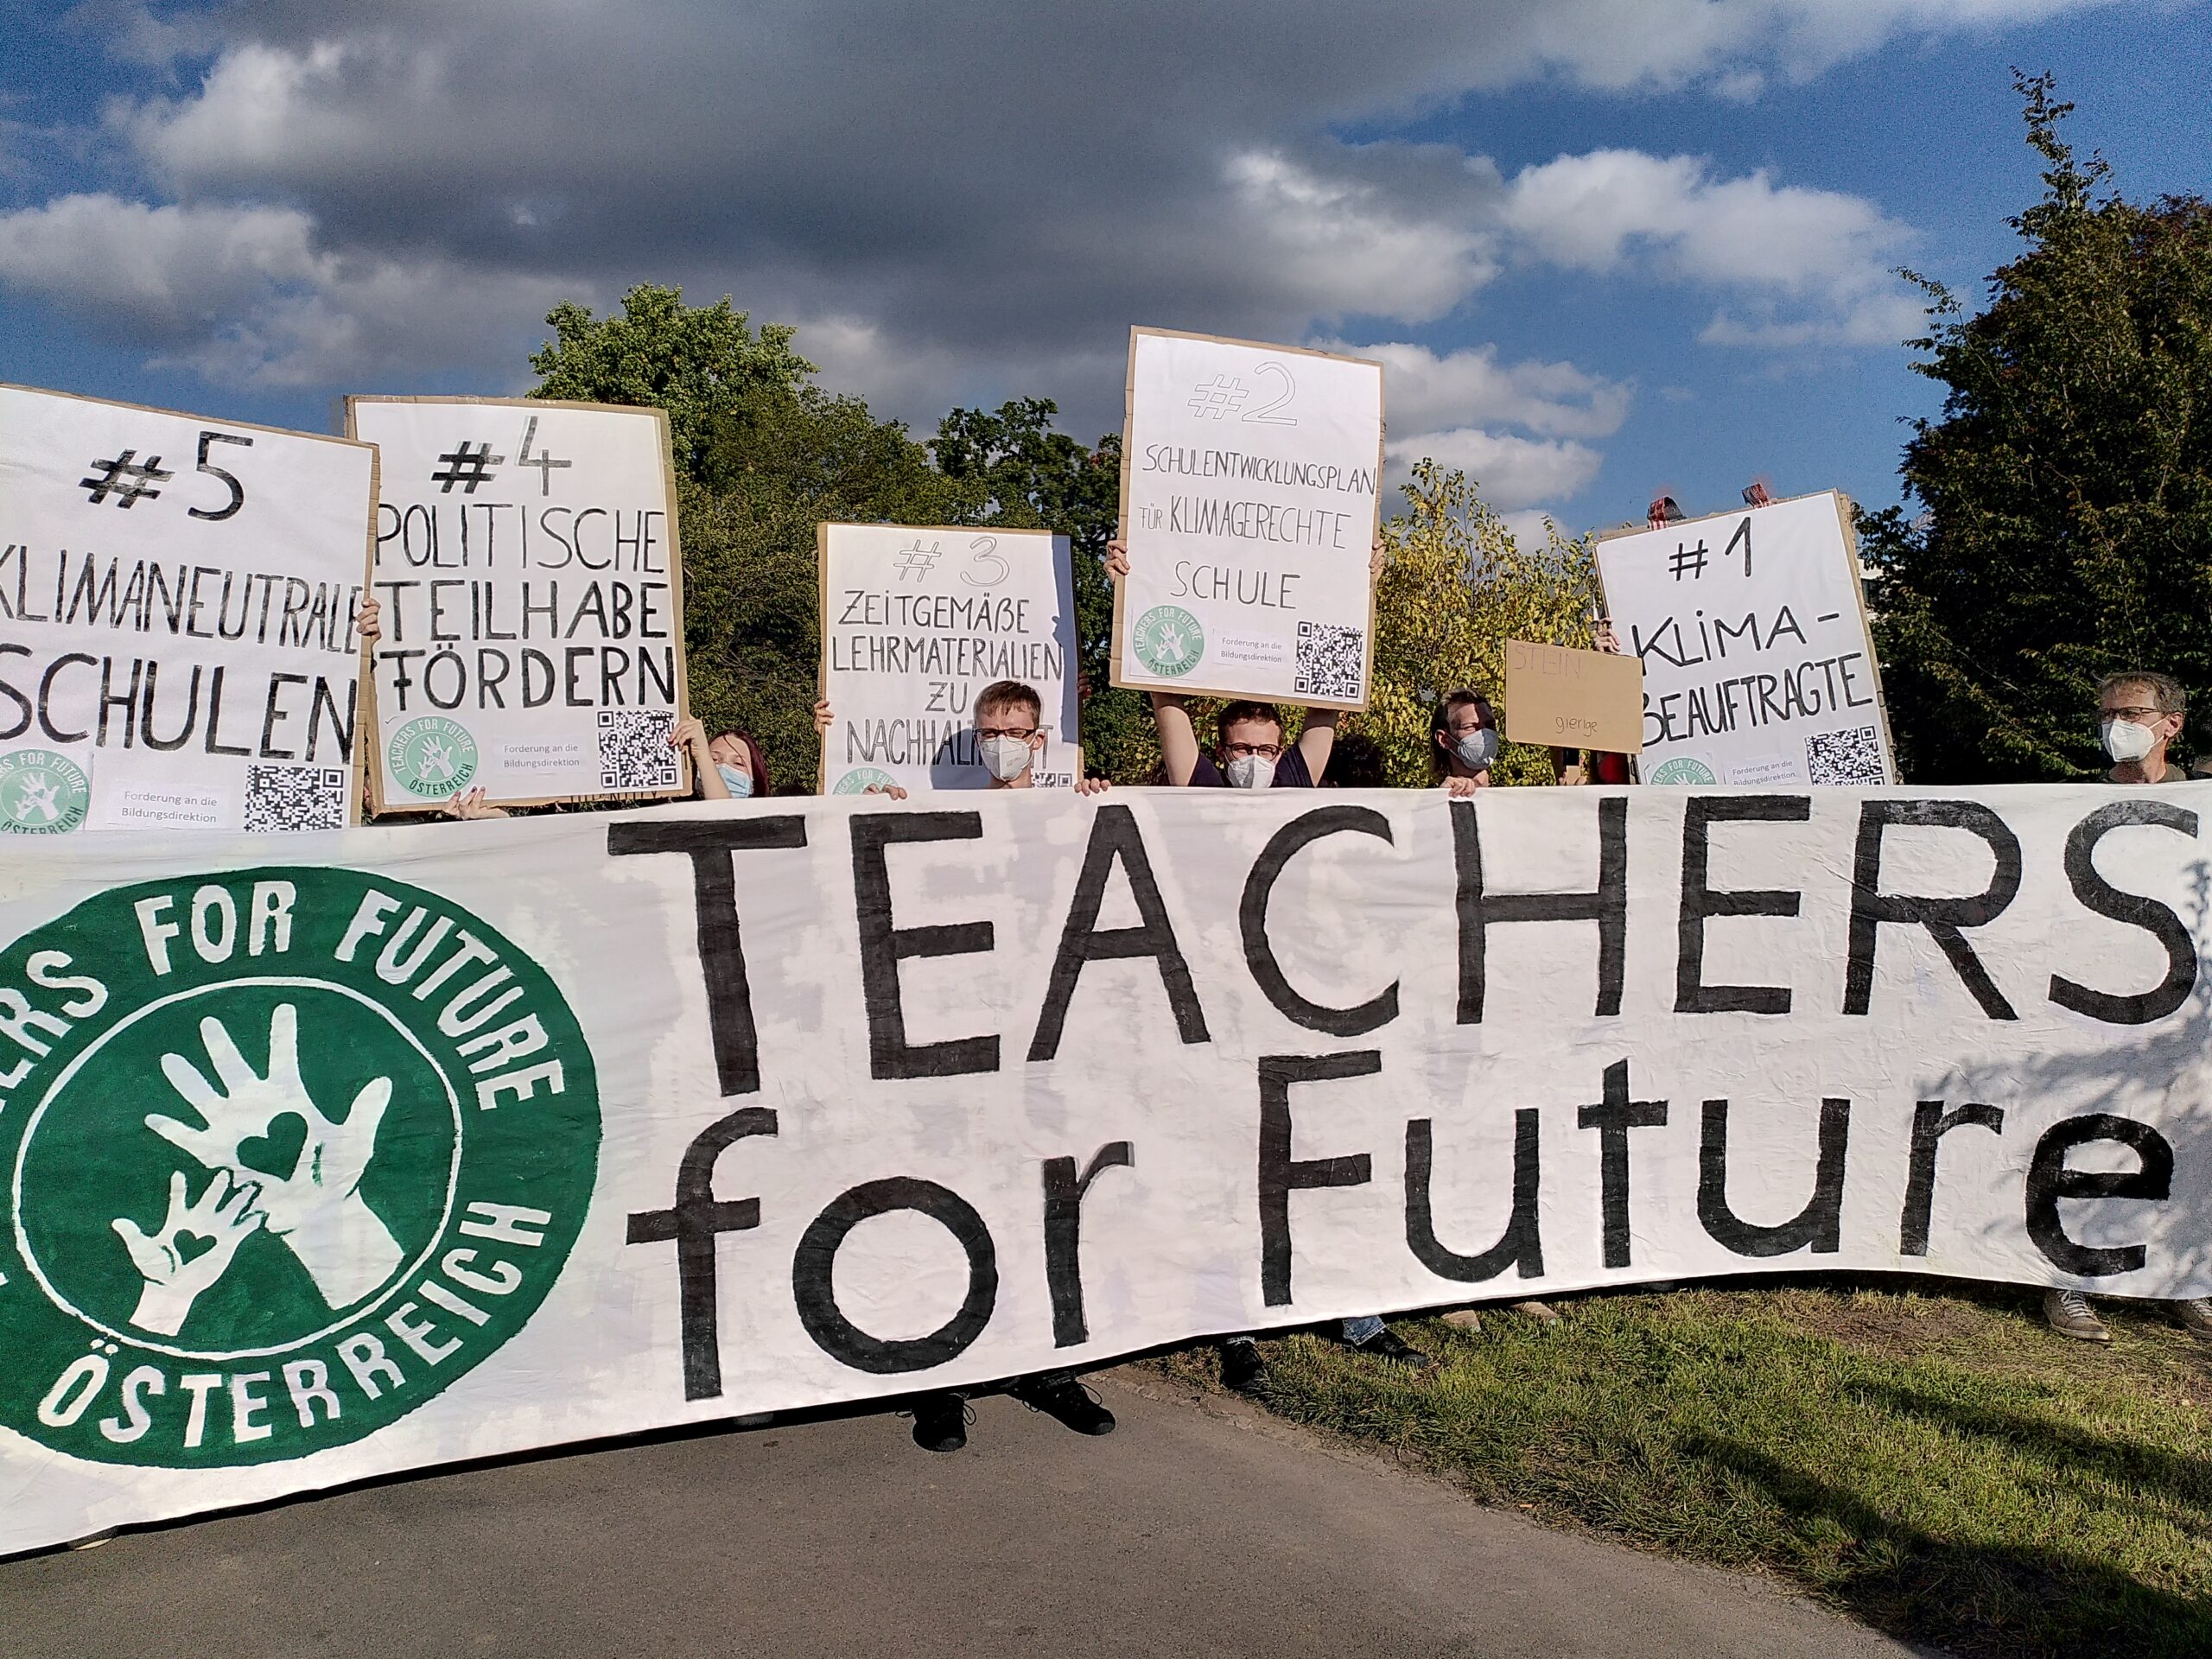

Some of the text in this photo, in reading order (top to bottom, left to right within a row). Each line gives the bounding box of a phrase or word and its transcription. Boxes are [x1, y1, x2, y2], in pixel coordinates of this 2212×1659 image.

[1142, 444, 1376, 495] SCHULENTWICKLUNGSPLAN
[375, 503, 665, 573] POLITISCHE
[1170, 495, 1352, 550] KLIMAGERECHTE
[1170, 561, 1300, 609] SCHULE
[374, 580, 668, 642] TEILHABE
[1134, 607, 1202, 652] TEACHERS FOR FUTURE
[832, 636, 1062, 680] LEHRMATERIALIEN
[1147, 650, 1199, 676] ÖSTERREICH
[1221, 650, 1282, 663] Bildungsdirektion
[1222, 638, 1259, 649] Forderung
[1271, 641, 1282, 650] die
[1514, 645, 1581, 679] STEIN
[925, 681, 968, 714] ZU
[391, 719, 474, 774] TEACHERS FOR FUTURE
[504, 745, 550, 753] Forderung
[504, 759, 580, 768] Bildungsdirektion
[20, 753, 86, 794] FOR FUTURE
[409, 763, 474, 795] ÖSTERREICH
[1668, 760, 1713, 783] FOR FUTURE
[1732, 766, 1770, 777] Forderung
[1781, 760, 1793, 768] die
[122, 807, 216, 823] Bildungsdirektion
[124, 791, 181, 805] Forderung
[200, 798, 217, 806] die
[607, 796, 2199, 1097] TEACHERS
[134, 880, 565, 1111] FOR FUTURE
[626, 1049, 2175, 1402] for Future
[37, 1200, 552, 1448] ÖSTERREICH
